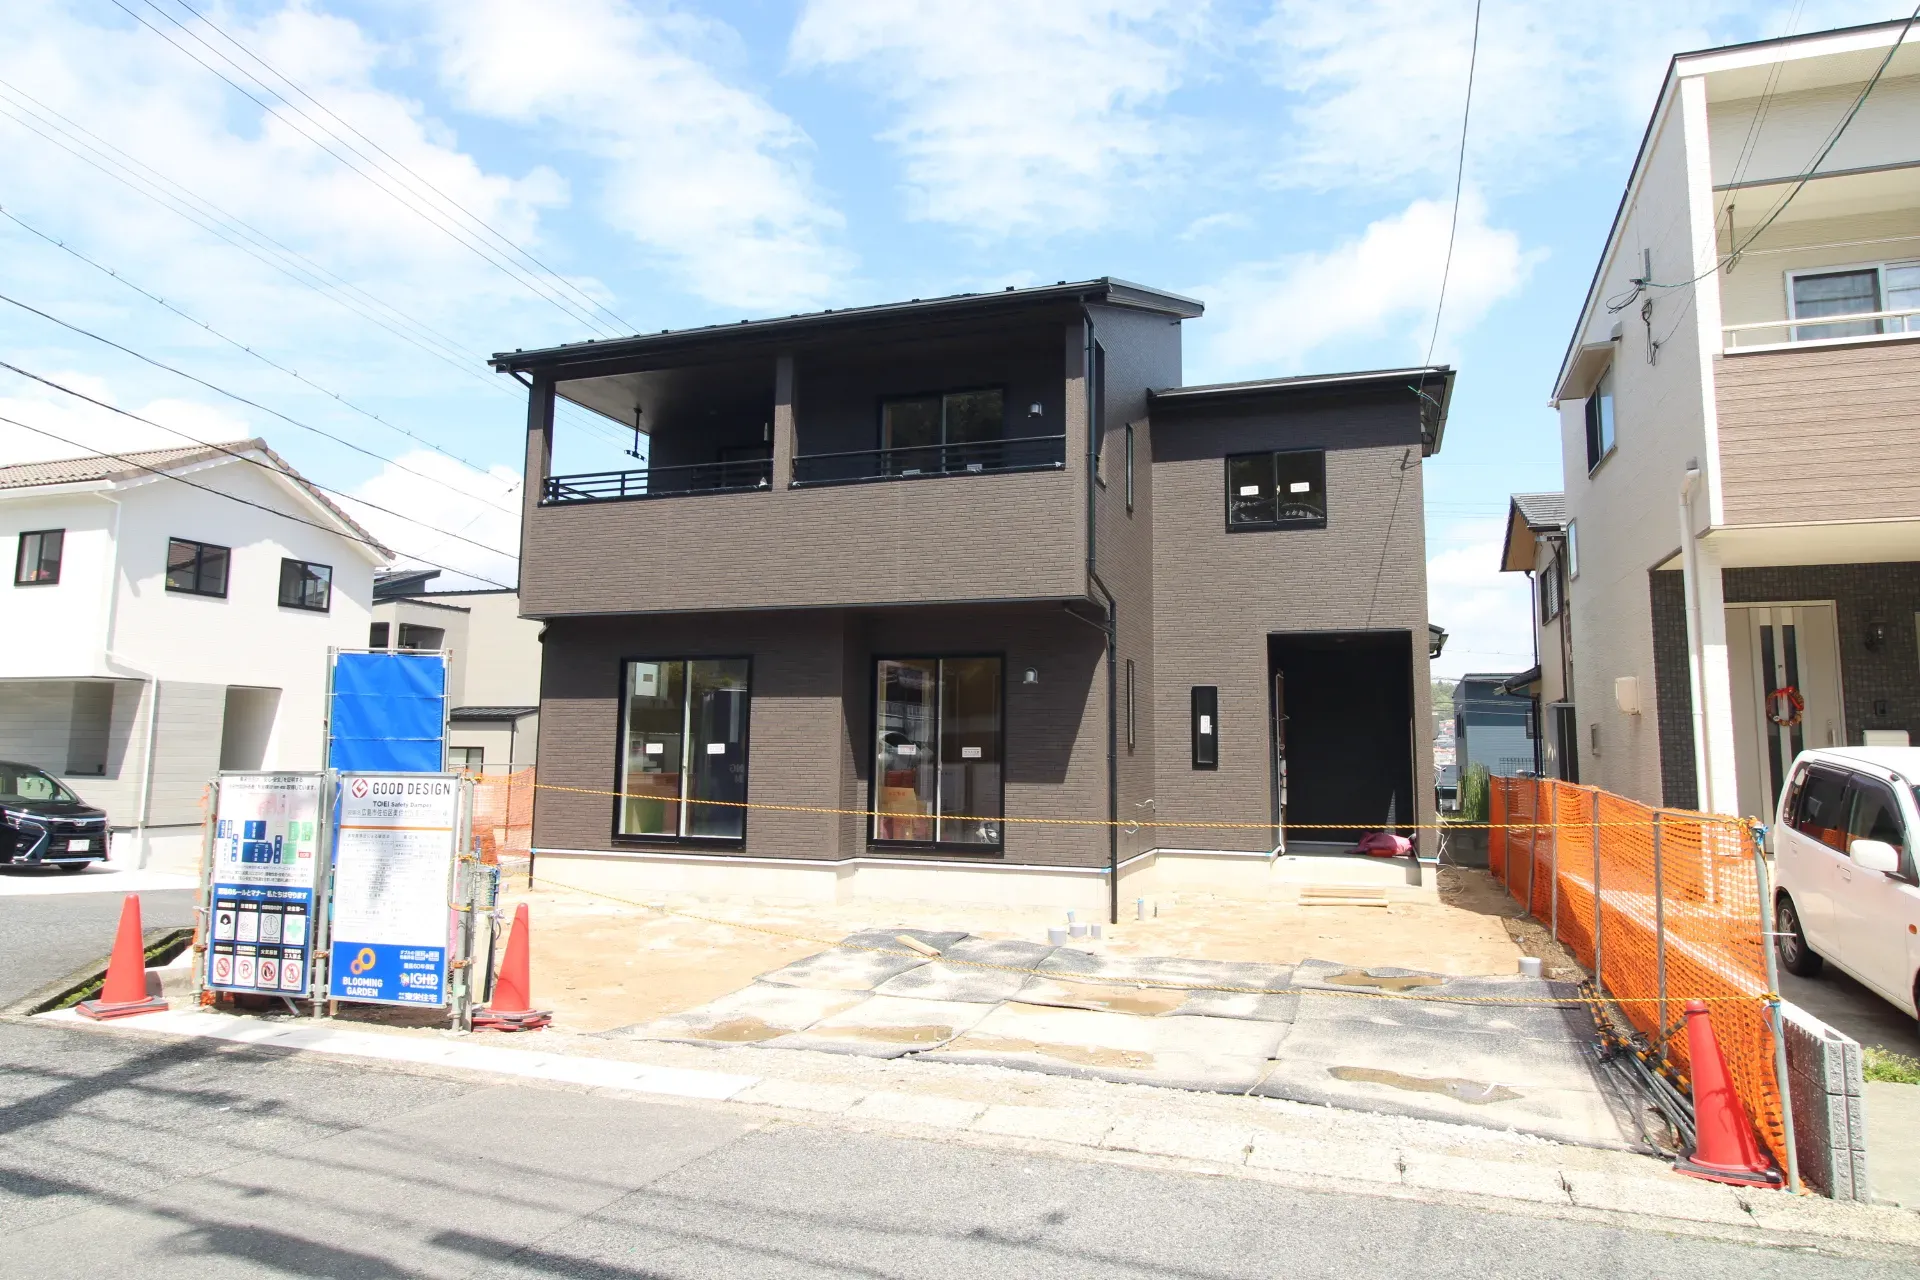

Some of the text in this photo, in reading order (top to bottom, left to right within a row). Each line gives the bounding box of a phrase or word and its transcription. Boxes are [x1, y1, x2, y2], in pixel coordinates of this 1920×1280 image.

[372, 782, 450, 795] GOOD DESIGN
[342, 976, 383, 988] BLOOMING
[346, 986, 379, 997] GARDEN
